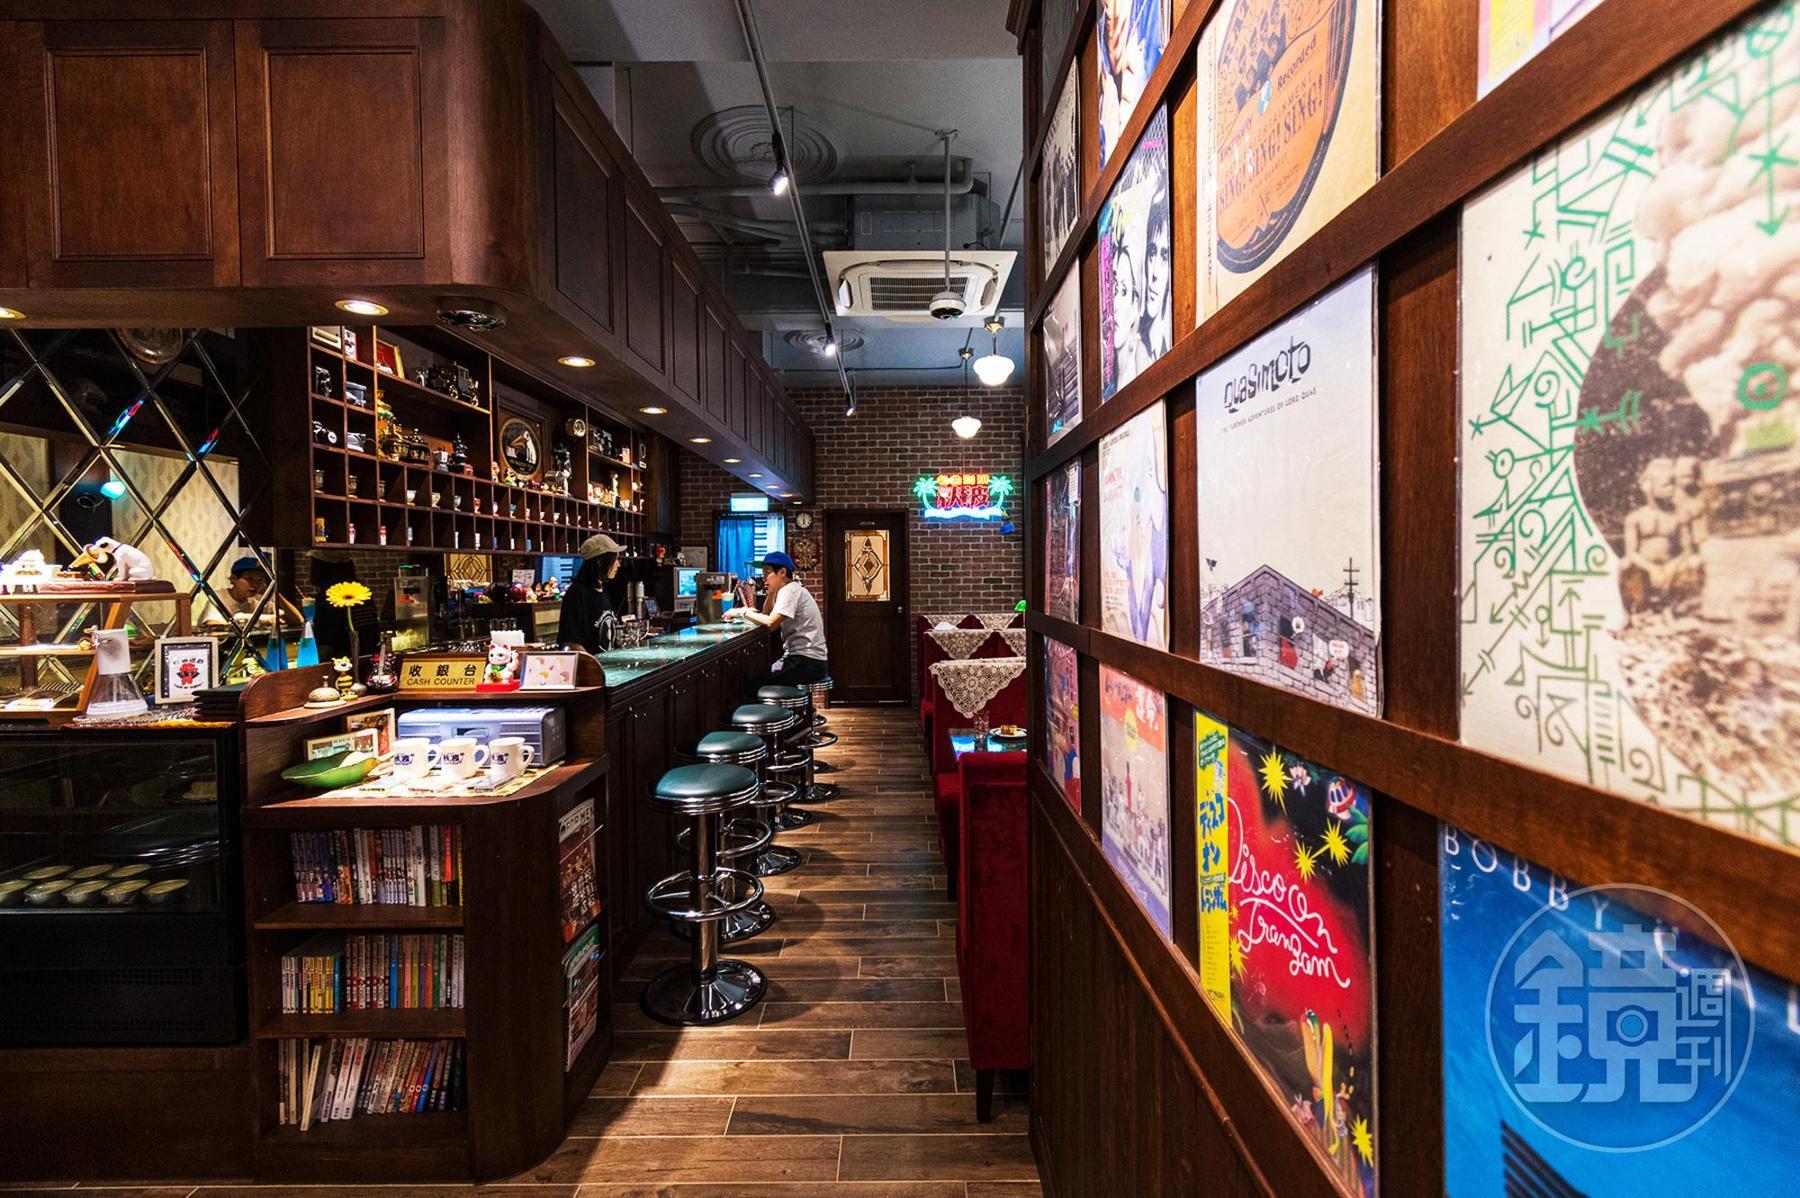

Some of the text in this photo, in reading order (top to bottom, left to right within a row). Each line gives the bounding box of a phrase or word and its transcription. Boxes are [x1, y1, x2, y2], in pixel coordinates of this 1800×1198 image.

[1277, 34, 1317, 91] Recorded
[1283, 73, 1323, 143] SING!
[406, 677, 476, 686] CASH COUNTER
[408, 663, 477, 678] 收銀台
